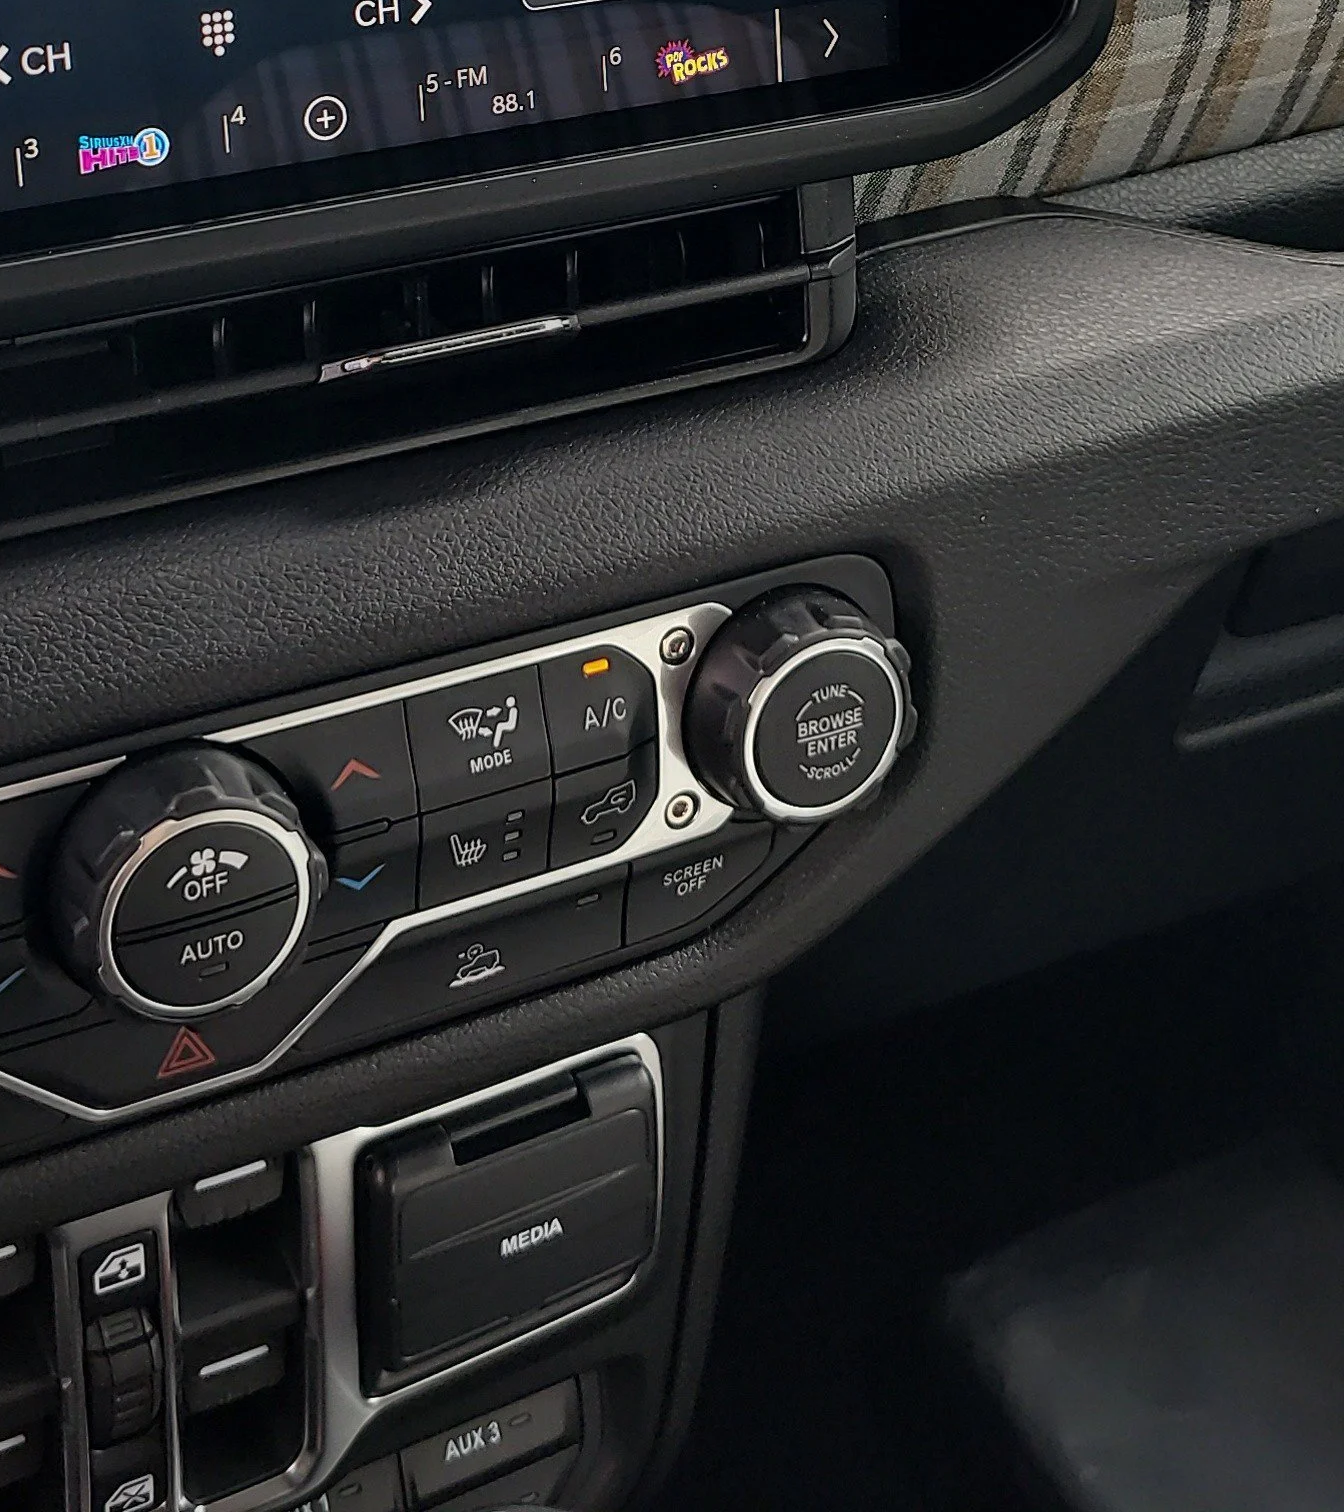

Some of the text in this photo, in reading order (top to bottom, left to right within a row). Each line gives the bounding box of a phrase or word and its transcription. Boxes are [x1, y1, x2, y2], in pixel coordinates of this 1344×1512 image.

[20, 42, 72, 76] CH
[609, 47, 622, 67] 6
[673, 50, 728, 81] ROCKS
[425, 72, 439, 93] 5
[457, 66, 488, 88] FM
[230, 106, 246, 126] 4
[491, 91, 536, 115] 88.1
[24, 138, 39, 159] 3
[143, 132, 161, 159] 1
[812, 683, 848, 703] TUNE
[584, 697, 627, 731] A/C
[797, 707, 863, 739] BROWSE
[806, 730, 857, 757] ENTER
[470, 749, 513, 774] MODE
[805, 754, 853, 780] SCROLL
[663, 854, 724, 887] SCREEN
[183, 873, 229, 902] OFF
[676, 875, 707, 896] OFF
[180, 930, 244, 965] AUTO
[500, 1217, 564, 1259] MEDIA
[445, 1421, 502, 1461] AUX 3
